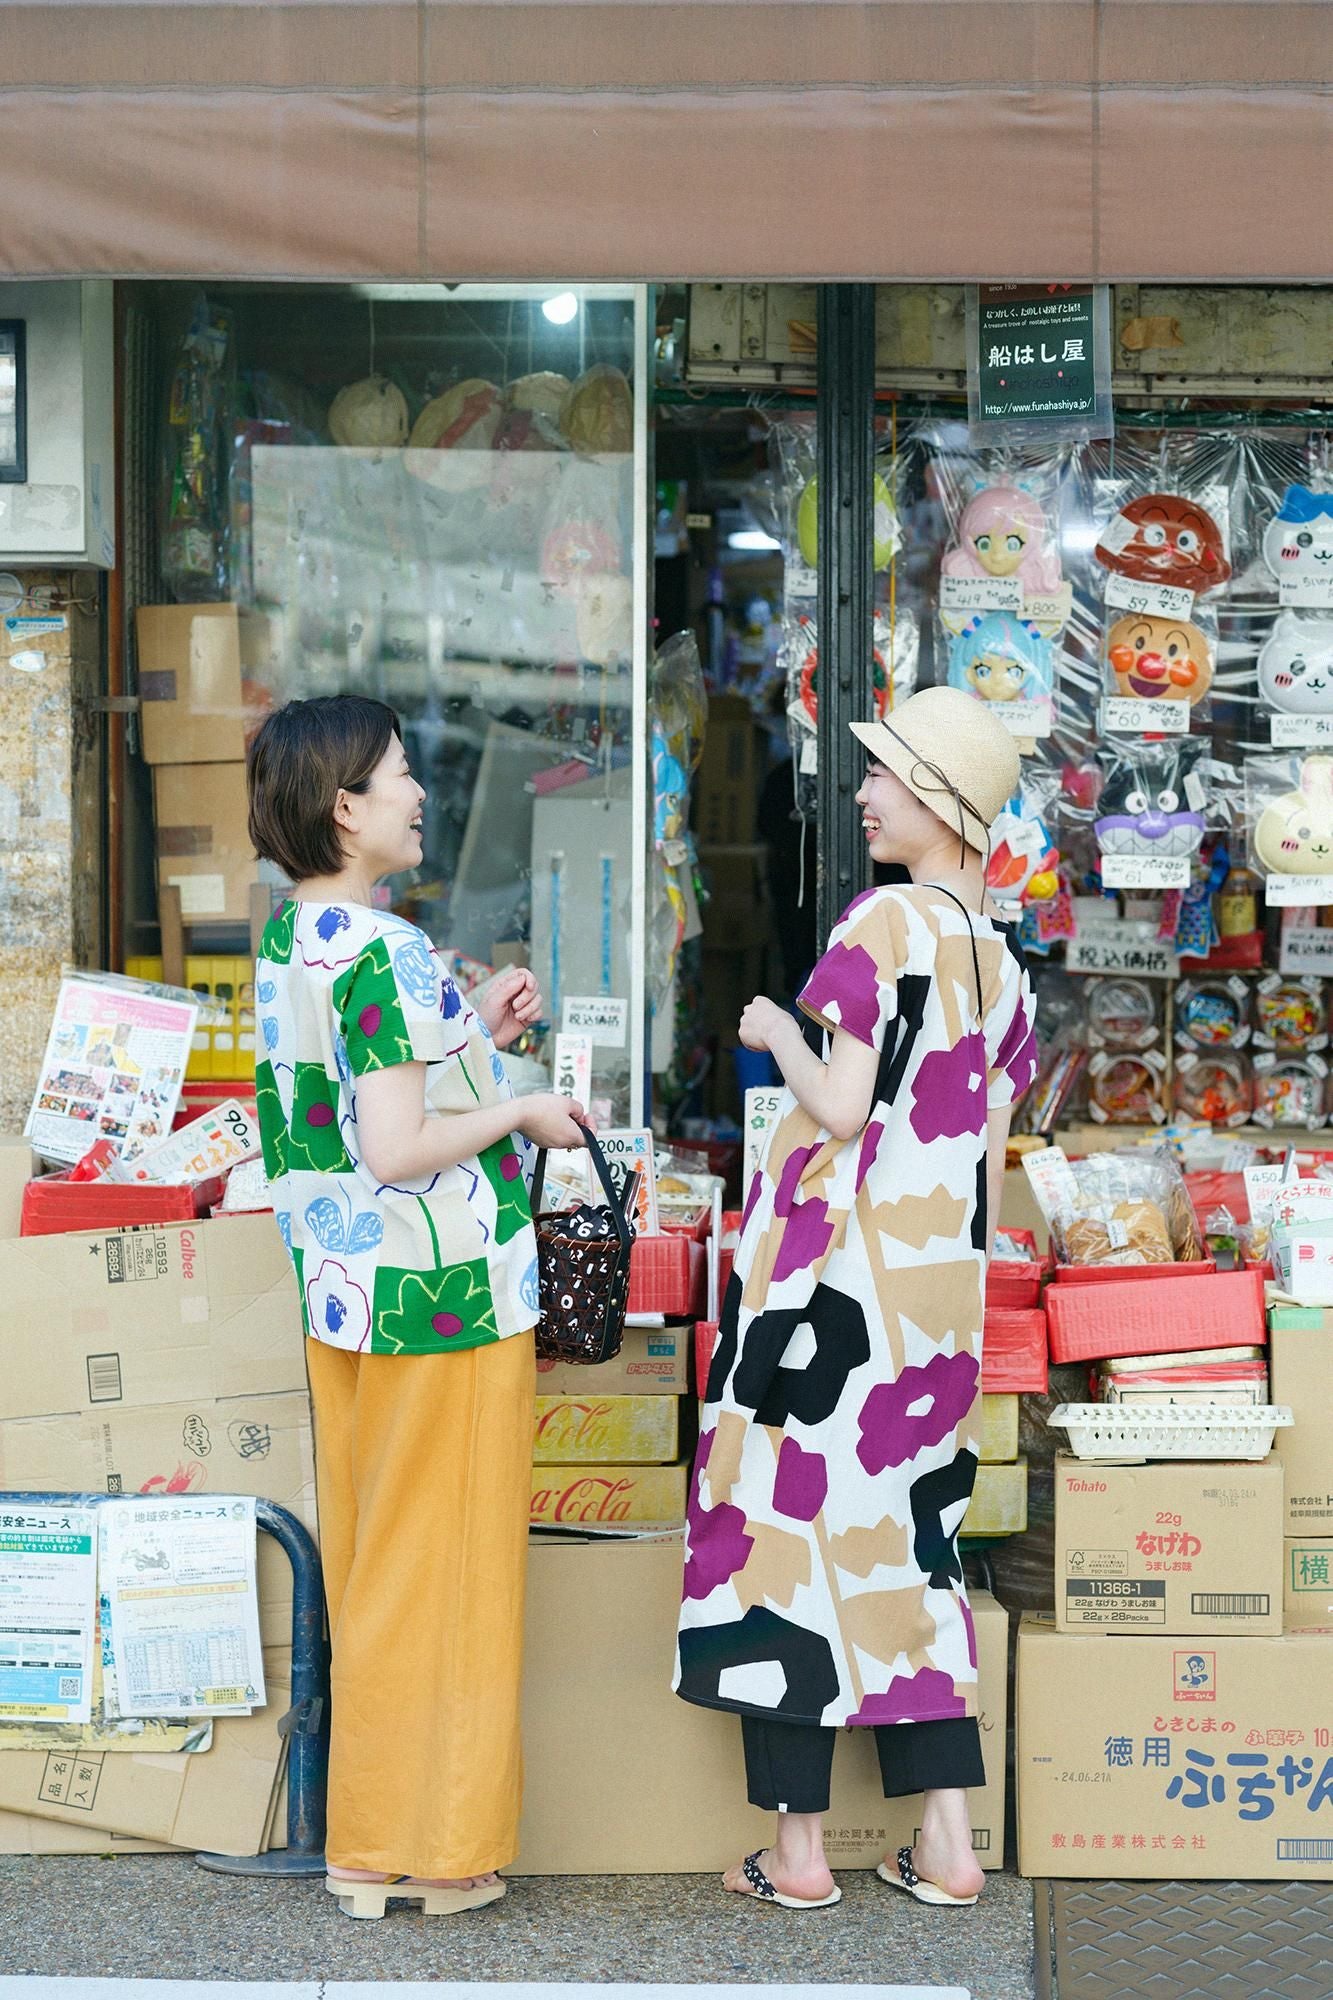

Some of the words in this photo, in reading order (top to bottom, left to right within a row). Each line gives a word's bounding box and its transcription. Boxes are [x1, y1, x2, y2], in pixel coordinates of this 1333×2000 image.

[986, 303, 1081, 319] なつかしく、たのしいお菓子と玩具
[988, 321, 1007, 329] treasure
[1029, 318, 1050, 326] nostalgic
[1051, 317, 1061, 325] toys
[988, 339, 1086, 368] 船はし屋
[985, 397, 1092, 415] http://www.funahashiya.jp/
[1128, 596, 1148, 613] 59
[1119, 712, 1141, 727] 60
[1078, 947, 1167, 970] 税込価格
[569, 1014, 620, 1027] 税込価格
[1252, 1172, 1277, 1183] 450
[577, 1221, 593, 1238] 6
[107, 1241, 119, 1280] 26684
[156, 1236, 168, 1274] 10593
[180, 1229, 196, 1279] Calbee
[188, 1417, 206, 1454] カルシウム
[1066, 1478, 1107, 1493] Tohato
[1290, 1497, 1322, 1505] 株式会社
[0, 1515, 71, 1529] 安全ニュース
[134, 1507, 227, 1523] 地域安全ニュース
[1156, 1512, 1182, 1527] 22g
[1136, 1531, 1202, 1557] なげわ
[1145, 1561, 1192, 1573] うましお味
[1300, 1555, 1330, 1585] 横
[1089, 1582, 1141, 1595] 11366-1
[1075, 1599, 1093, 1607] 22g
[1095, 1599, 1118, 1607] なげわ
[1121, 1600, 1157, 1608] うましお味
[1082, 1611, 1103, 1622] 22g
[1111, 1612, 1149, 1622] 28Packs
[1153, 1717, 1236, 1733] しきしまの
[1245, 1729, 1304, 1746] ふ菓子
[1314, 1728, 1333, 1747] 10
[1104, 1736, 1170, 1767] 徳用
[48, 1762, 67, 1797] 品名
[74, 1767, 93, 1802] 入数
[1051, 1833, 1207, 1849] 敷島産業株式会社
